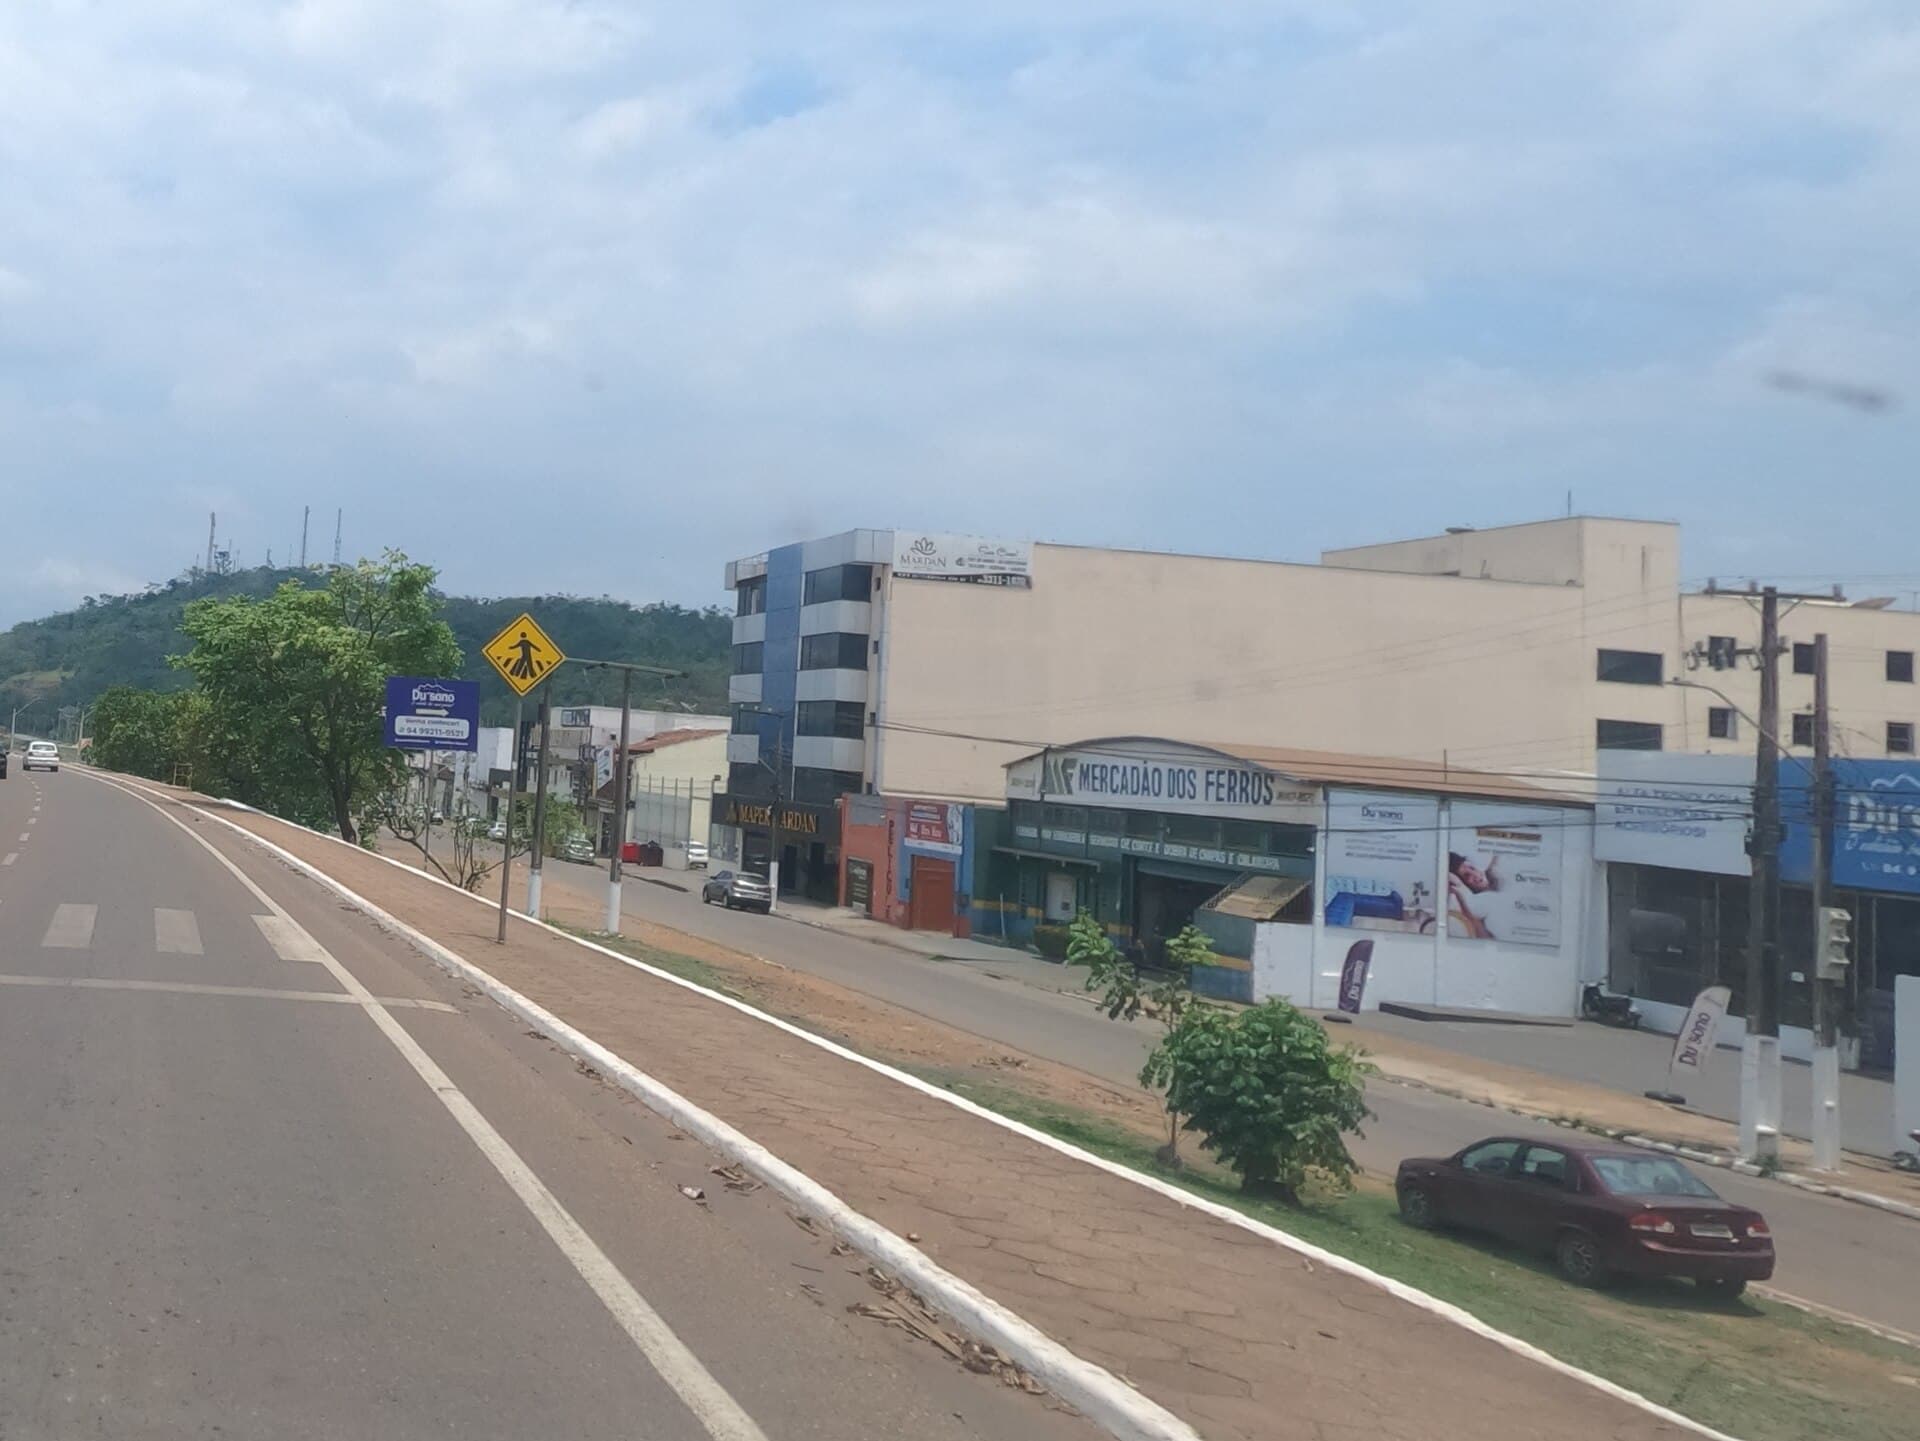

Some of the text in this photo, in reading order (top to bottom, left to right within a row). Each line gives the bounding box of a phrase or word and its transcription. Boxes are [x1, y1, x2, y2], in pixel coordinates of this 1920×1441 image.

[1079, 760, 1275, 806] MERCADÃO DOS FERROS
